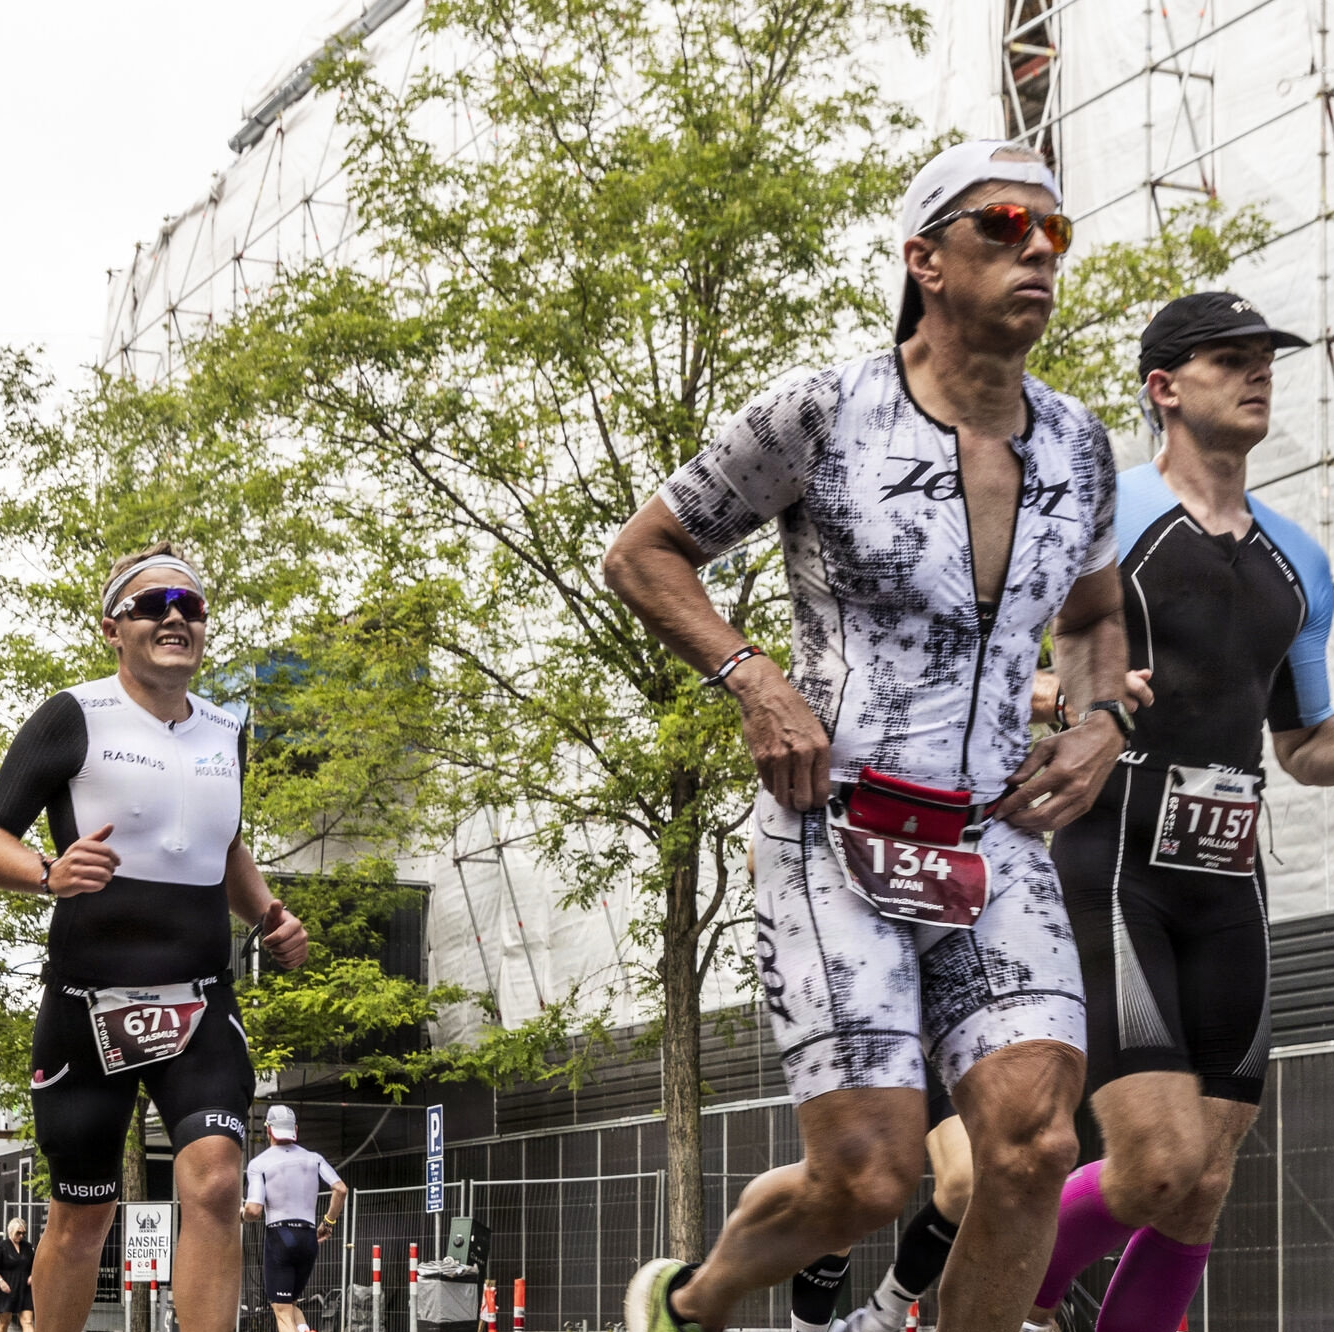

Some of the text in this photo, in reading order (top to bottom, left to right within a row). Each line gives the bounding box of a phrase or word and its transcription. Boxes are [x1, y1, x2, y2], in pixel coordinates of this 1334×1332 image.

[200, 709, 239, 732] FUSION
[103, 750, 166, 771] RASMUS
[1187, 802, 1254, 840] 1157
[1198, 836, 1240, 850] WILLIAM
[867, 838, 953, 880] 134
[889, 878, 924, 892] IVAN
[123, 1007, 181, 1036] 671
[137, 1029, 179, 1045] RASMUS
[430, 1112, 440, 1152] P
[59, 1181, 116, 1198] FUSION
[127, 1248, 168, 1259] SECURITY
